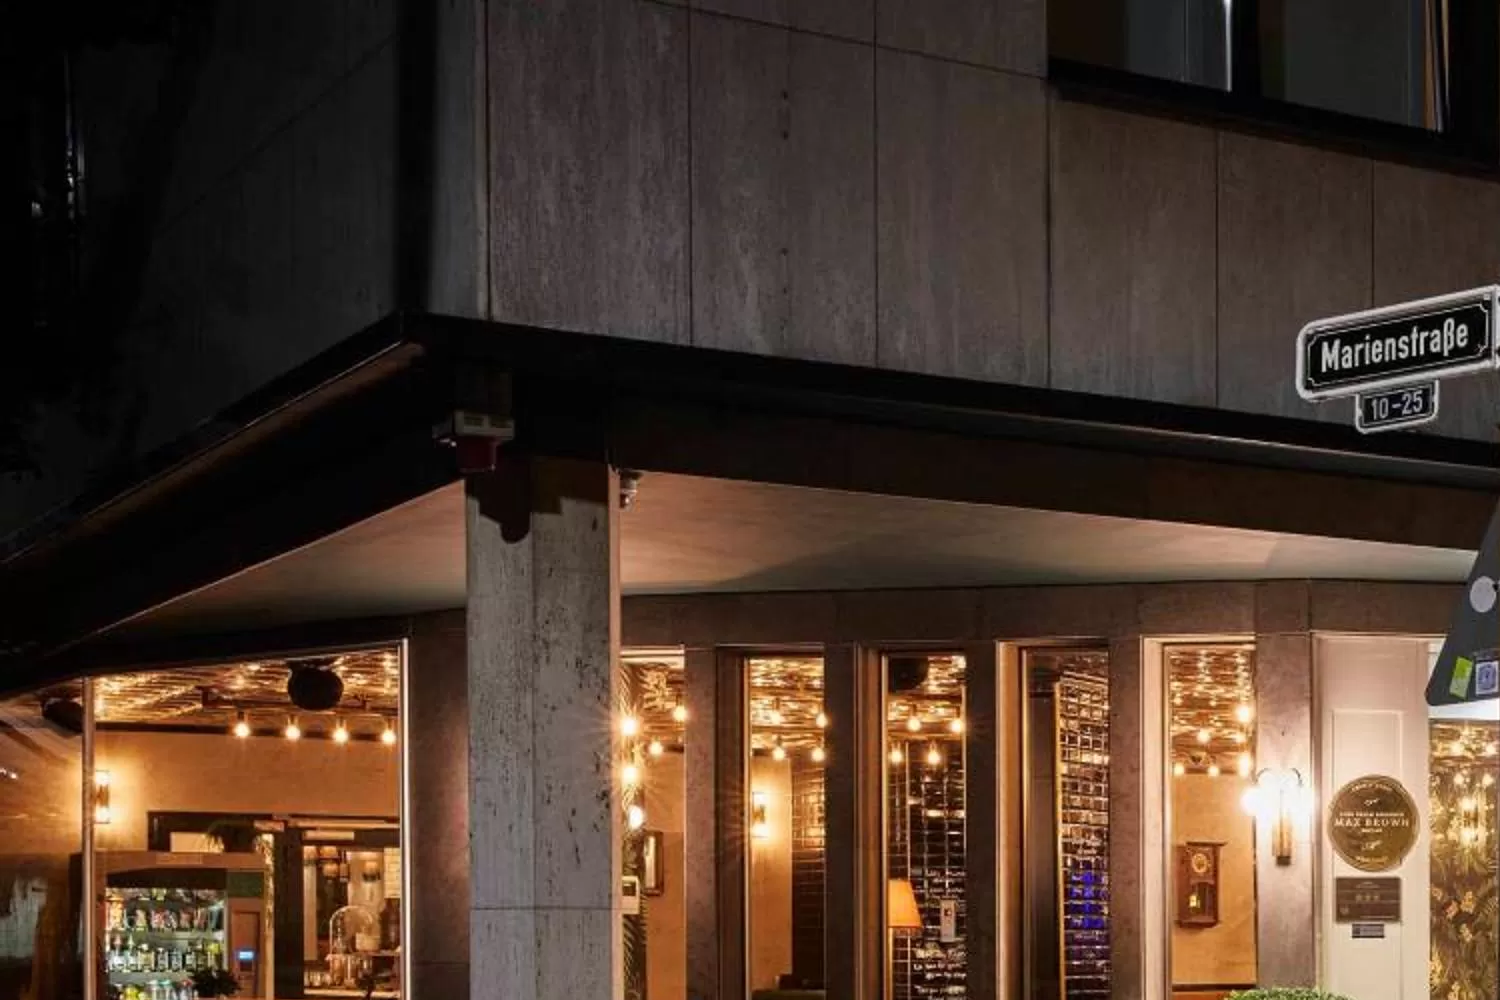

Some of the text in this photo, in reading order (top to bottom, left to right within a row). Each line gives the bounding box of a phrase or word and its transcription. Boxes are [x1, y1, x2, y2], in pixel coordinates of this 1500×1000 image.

[1321, 317, 1469, 373] Marienstraße
[1334, 817, 1410, 828] MAX BROWN
